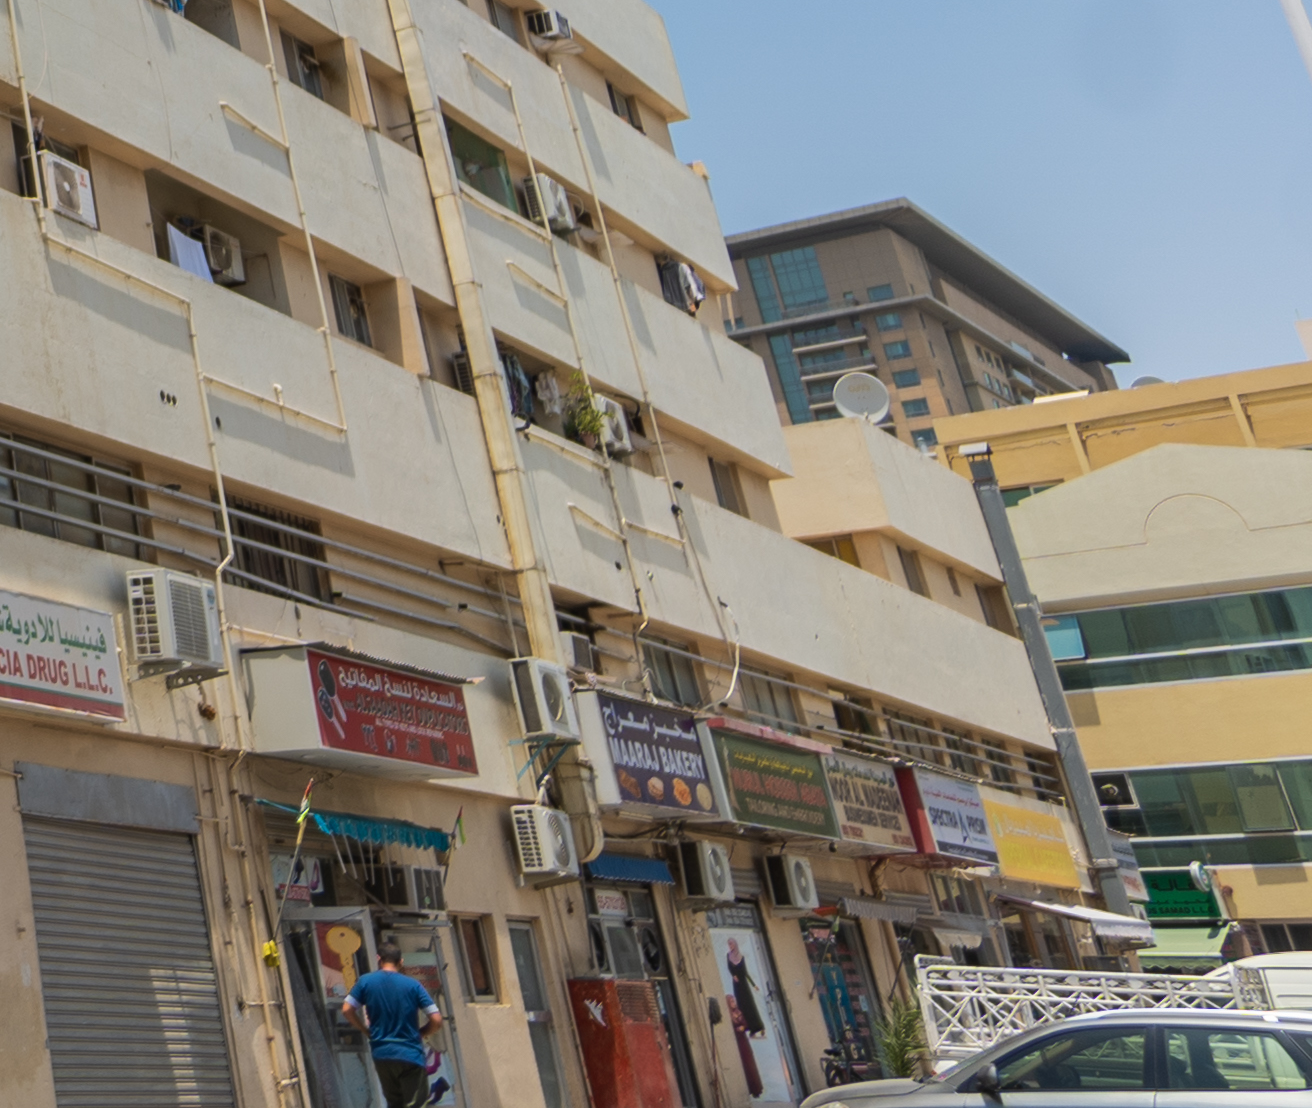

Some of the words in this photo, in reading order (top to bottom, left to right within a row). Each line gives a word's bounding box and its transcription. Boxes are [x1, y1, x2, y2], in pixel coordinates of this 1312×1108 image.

[57, 619, 107, 660] فينيسيا
[26, 653, 69, 686] DRUG
[72, 663, 113, 695] L.L.C.
[608, 737, 660, 772] MAARAJ
[659, 745, 705, 780] BAKERY
[928, 805, 959, 830] SPECTRA
